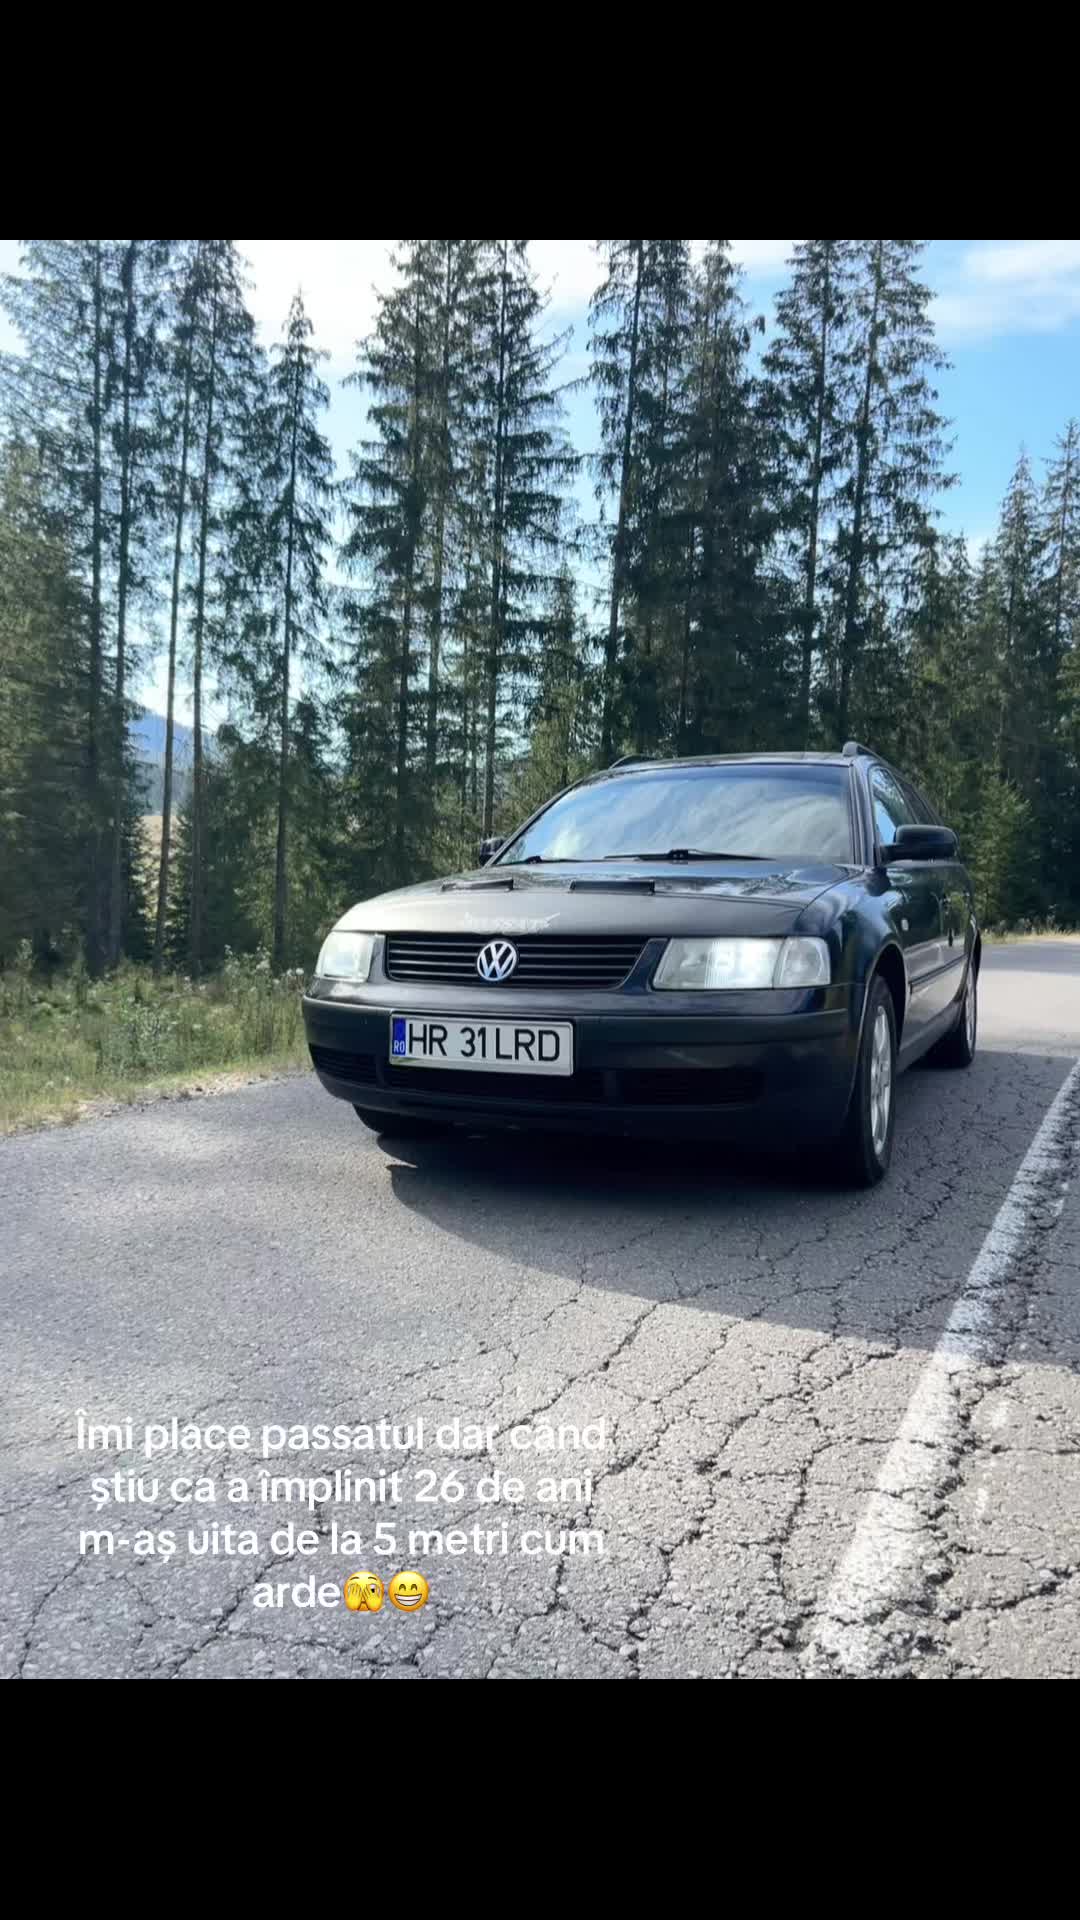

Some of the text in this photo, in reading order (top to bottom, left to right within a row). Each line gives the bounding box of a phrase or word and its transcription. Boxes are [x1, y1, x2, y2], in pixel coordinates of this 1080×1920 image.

[409, 1023, 560, 1062] HR 31 LRD
